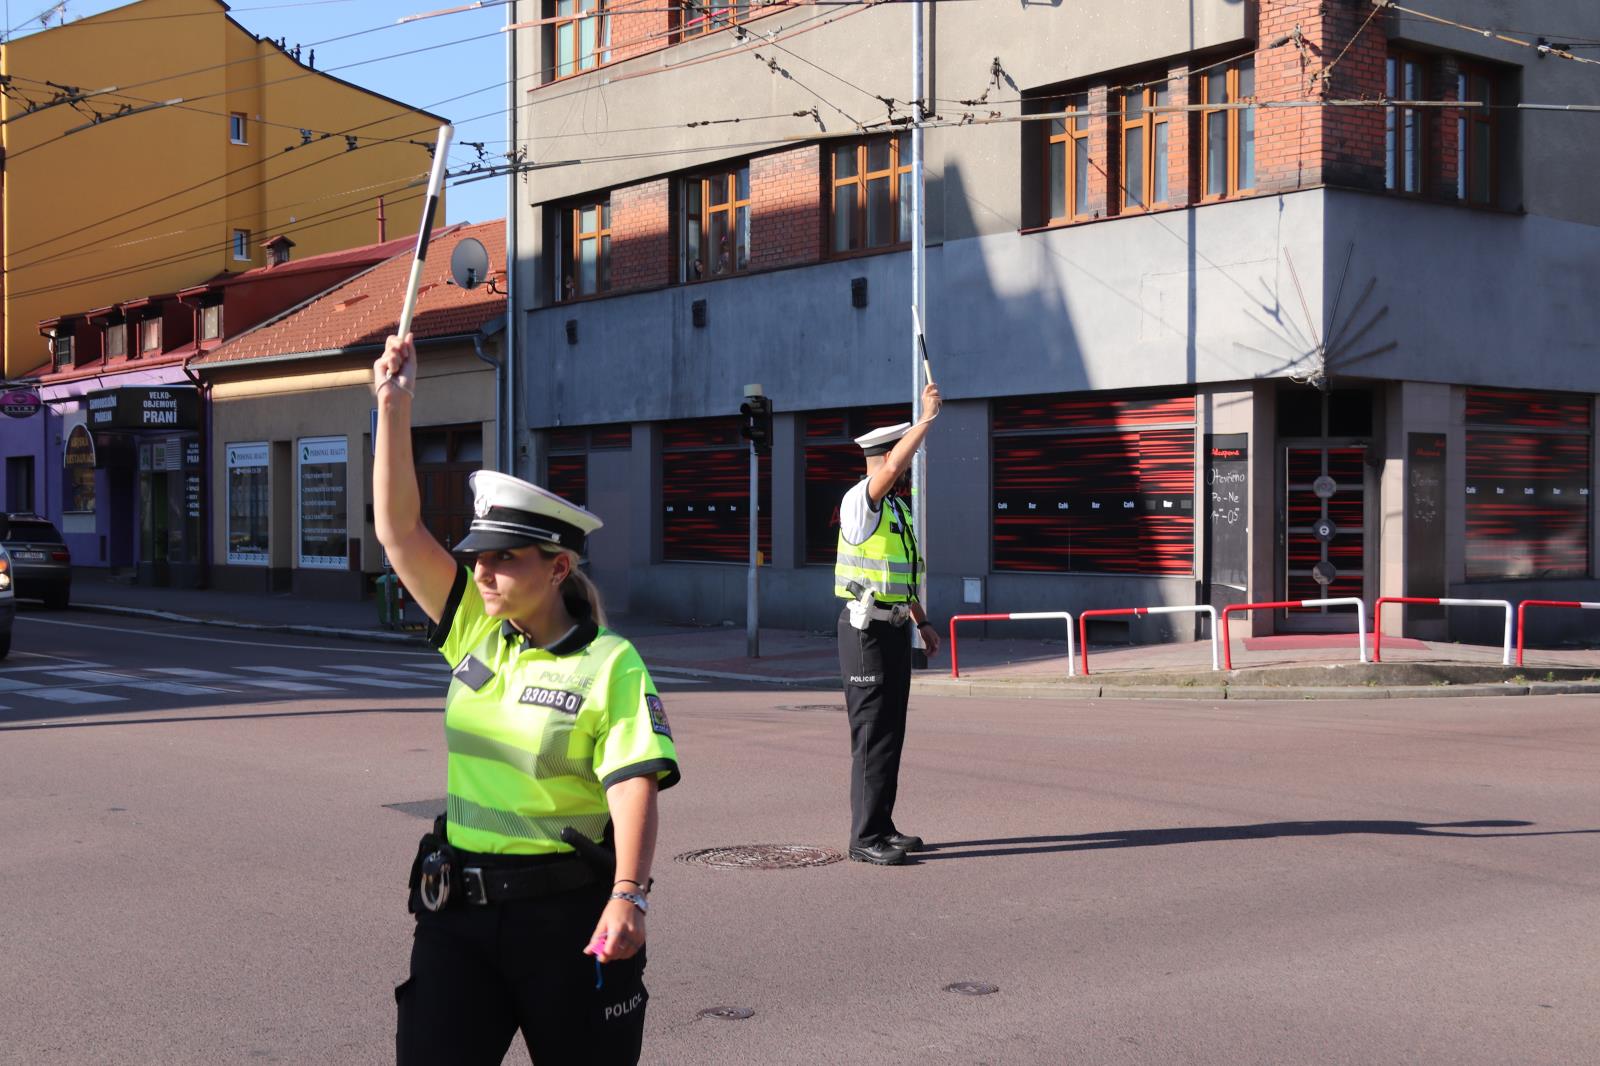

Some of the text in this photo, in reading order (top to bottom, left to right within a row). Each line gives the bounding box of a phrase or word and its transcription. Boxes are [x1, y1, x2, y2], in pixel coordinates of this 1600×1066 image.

[149, 391, 171, 399] VELKO-
[143, 399, 177, 408] OBJEMOVÉ
[143, 408, 177, 423] PRANÍ
[521, 687, 577, 710] 330550
